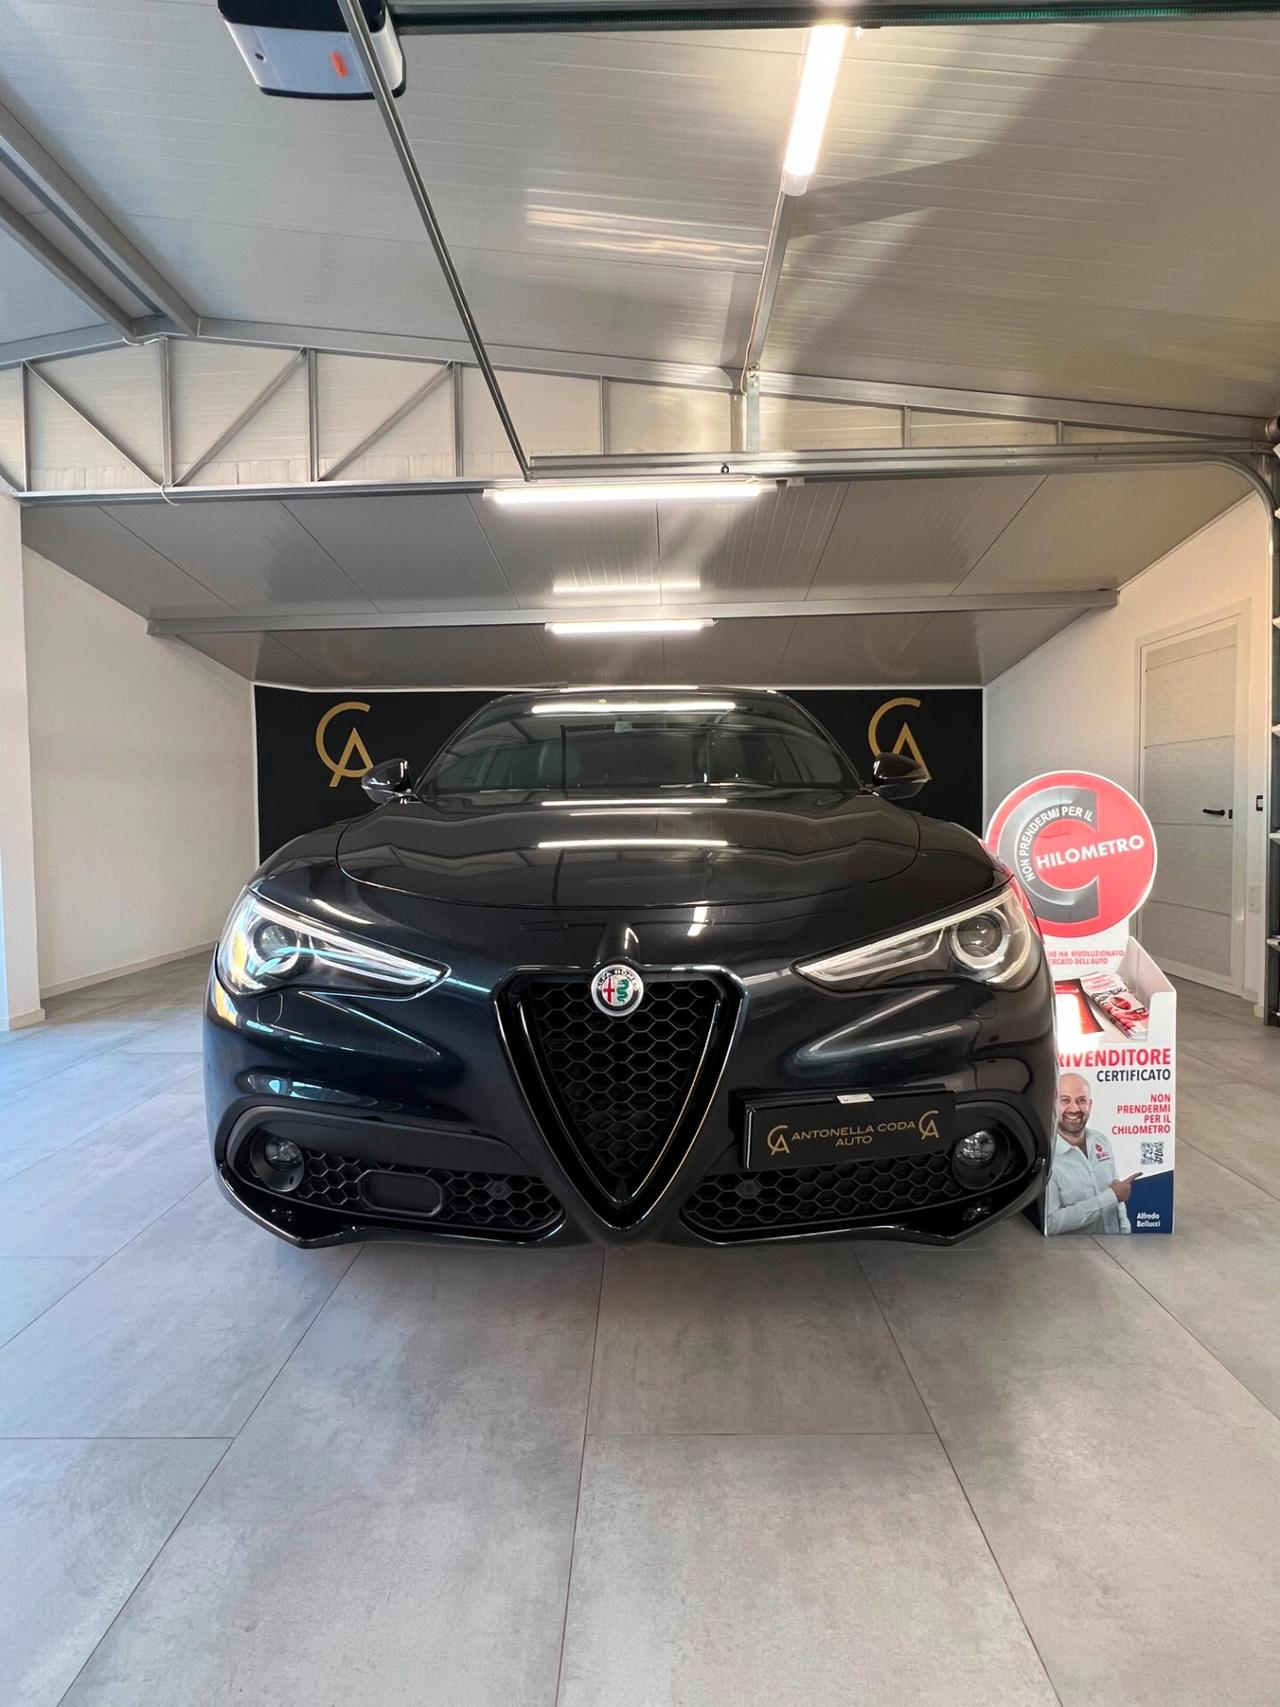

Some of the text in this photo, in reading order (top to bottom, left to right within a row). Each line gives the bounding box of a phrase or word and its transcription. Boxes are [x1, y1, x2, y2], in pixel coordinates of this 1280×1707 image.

[1019, 806, 1095, 882] NON PRENDERMI PER IL
[1096, 1068, 1171, 1082] CERTIFICATO
[1150, 1093, 1170, 1103] NON
[1117, 1104, 1171, 1114] PRENDERMI
[1144, 1114, 1171, 1124] PER IL
[791, 1125, 874, 1141] ANTONELLA
[877, 1120, 916, 1132] CODA
[1111, 1124, 1171, 1135] CHILOMETRO
[835, 1136, 873, 1147] AUTO
[1136, 1220, 1160, 1228] Bellucci
